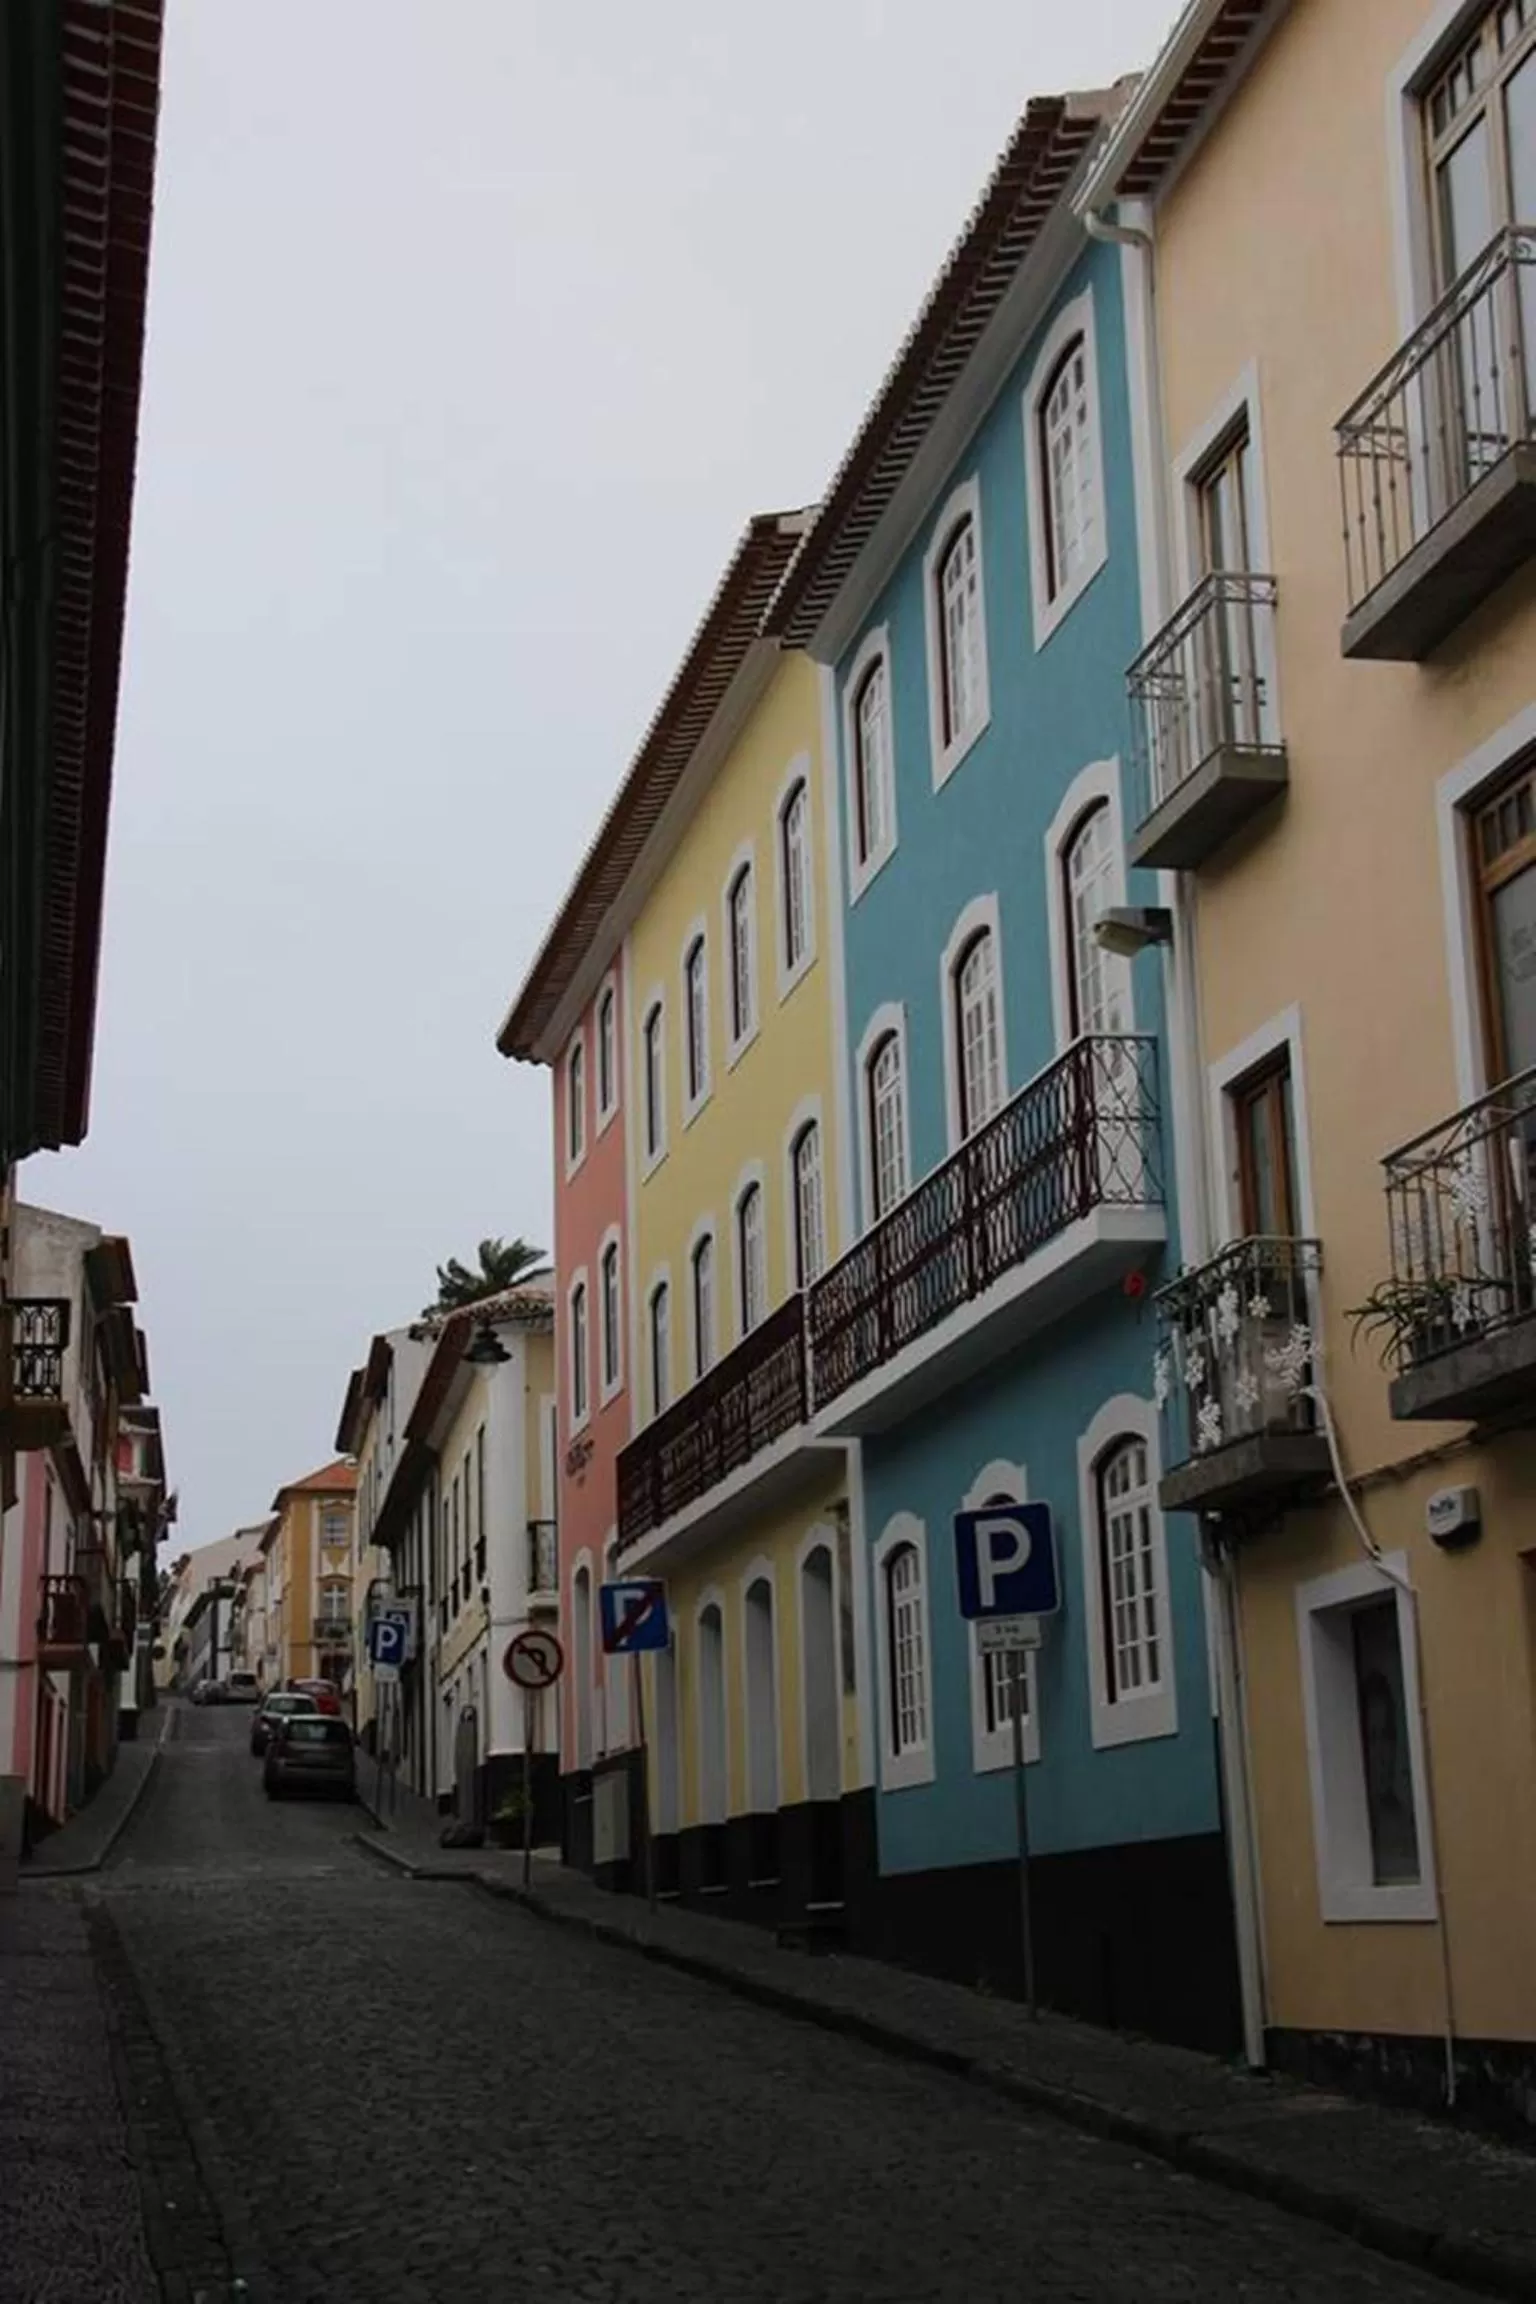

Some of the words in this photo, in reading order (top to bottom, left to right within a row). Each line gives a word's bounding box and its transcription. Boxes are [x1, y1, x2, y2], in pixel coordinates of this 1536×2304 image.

[974, 1517, 1033, 1609] P
[375, 1623, 399, 1660] P
[612, 1589, 654, 1648] P
